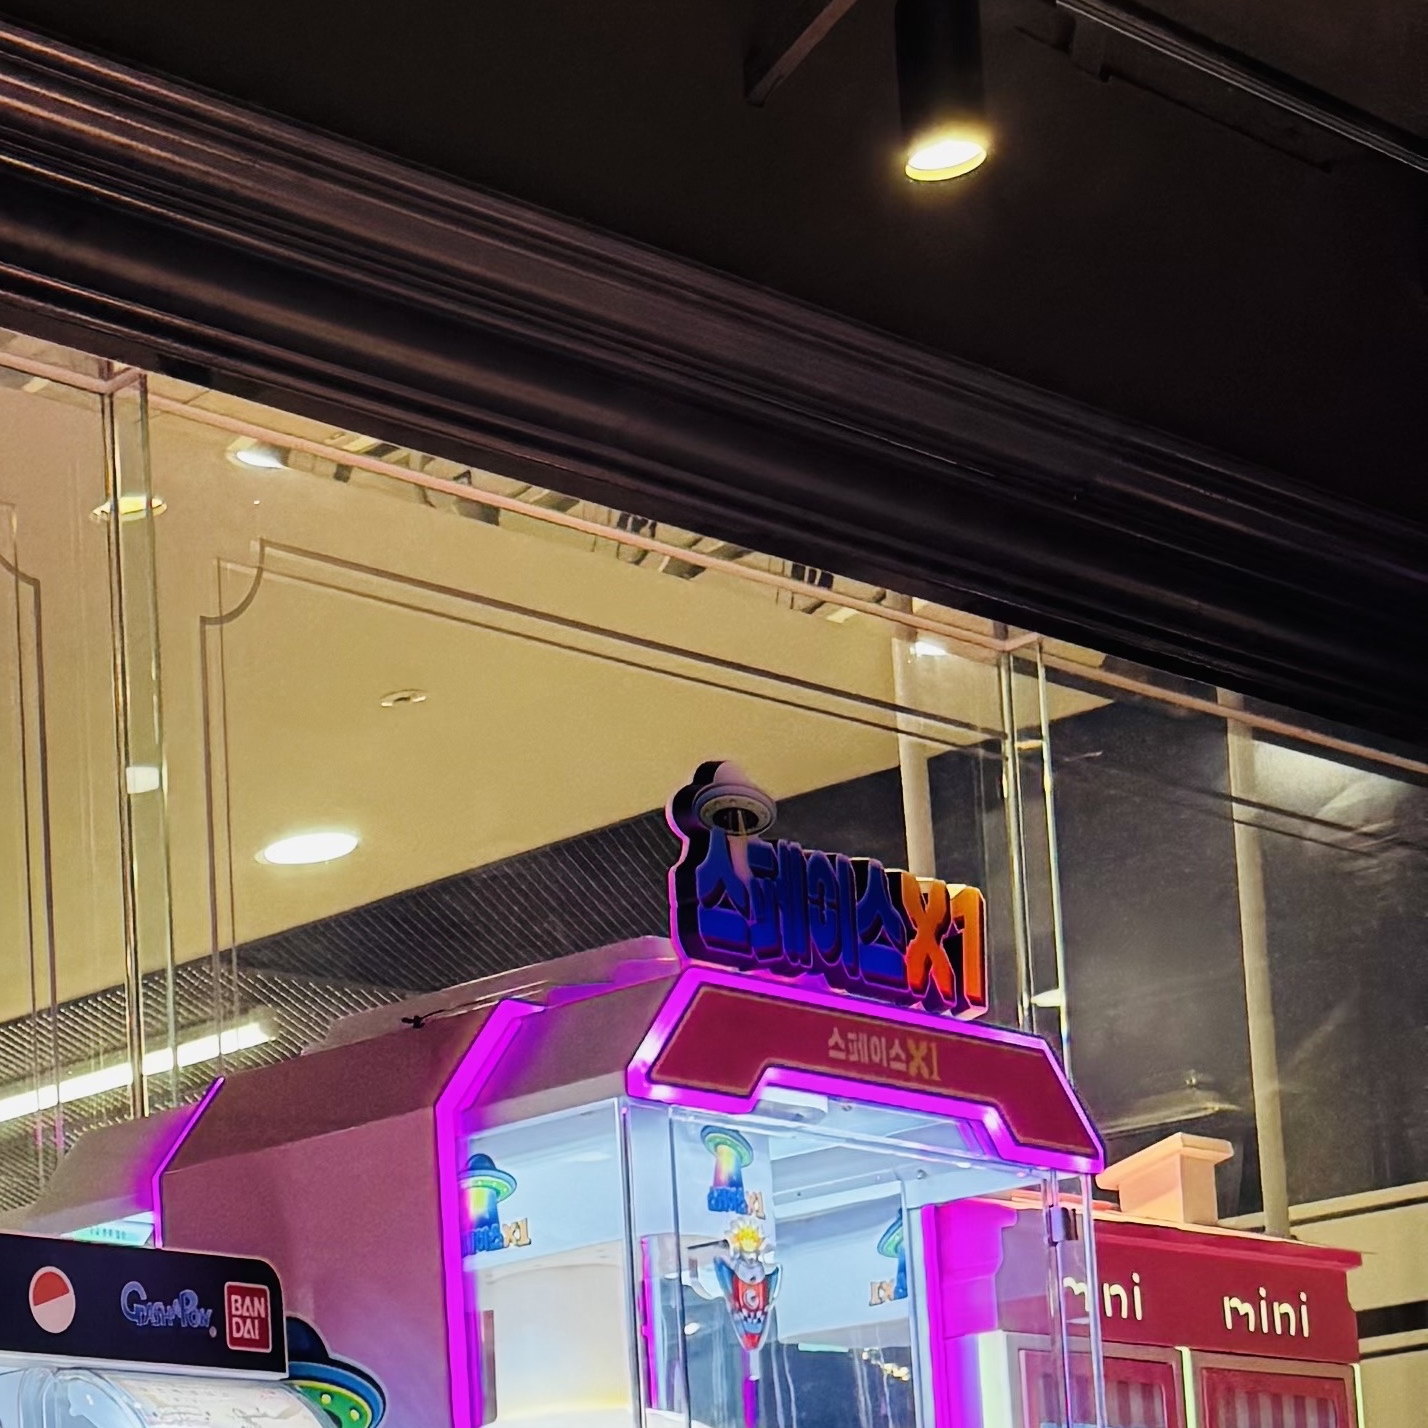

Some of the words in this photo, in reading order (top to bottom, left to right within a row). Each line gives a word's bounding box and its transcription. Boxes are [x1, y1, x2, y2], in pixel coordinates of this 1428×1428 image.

[230, 1293, 265, 1320] BAN
[1223, 1287, 1310, 1339] mini
[231, 1315, 260, 1341] DAI
